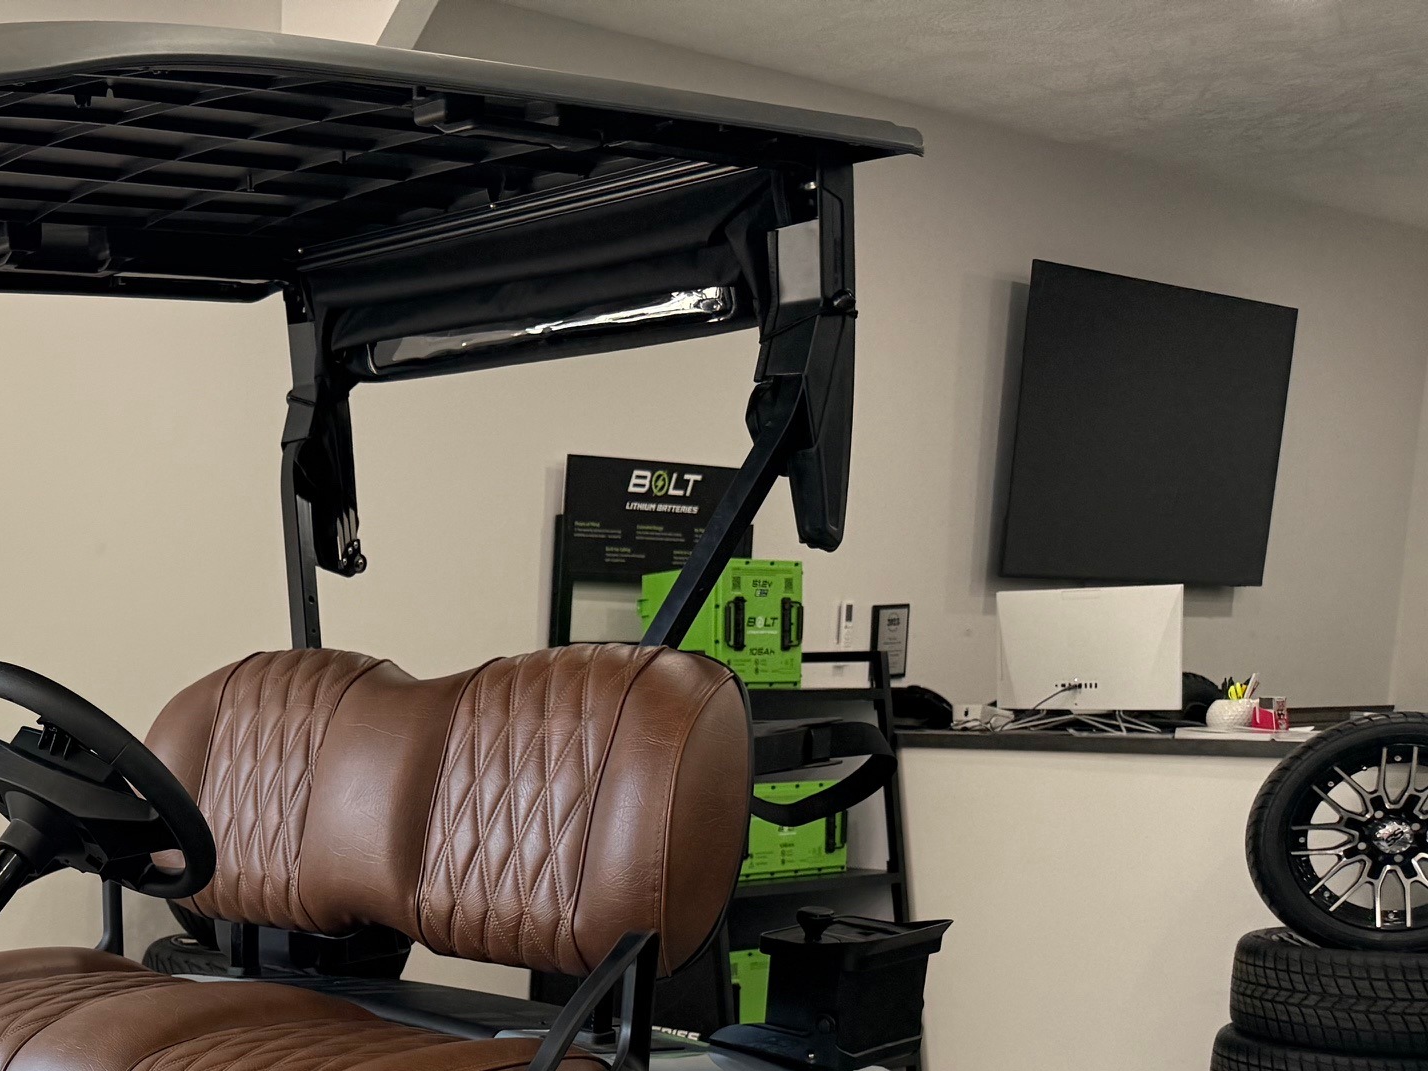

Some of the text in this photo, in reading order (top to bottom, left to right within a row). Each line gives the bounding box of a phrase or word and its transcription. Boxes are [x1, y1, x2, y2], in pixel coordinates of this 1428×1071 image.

[627, 469, 702, 497] BOLT
[625, 501, 699, 514] LITHIUM BATTERIES
[746, 616, 778, 628] BOLT
